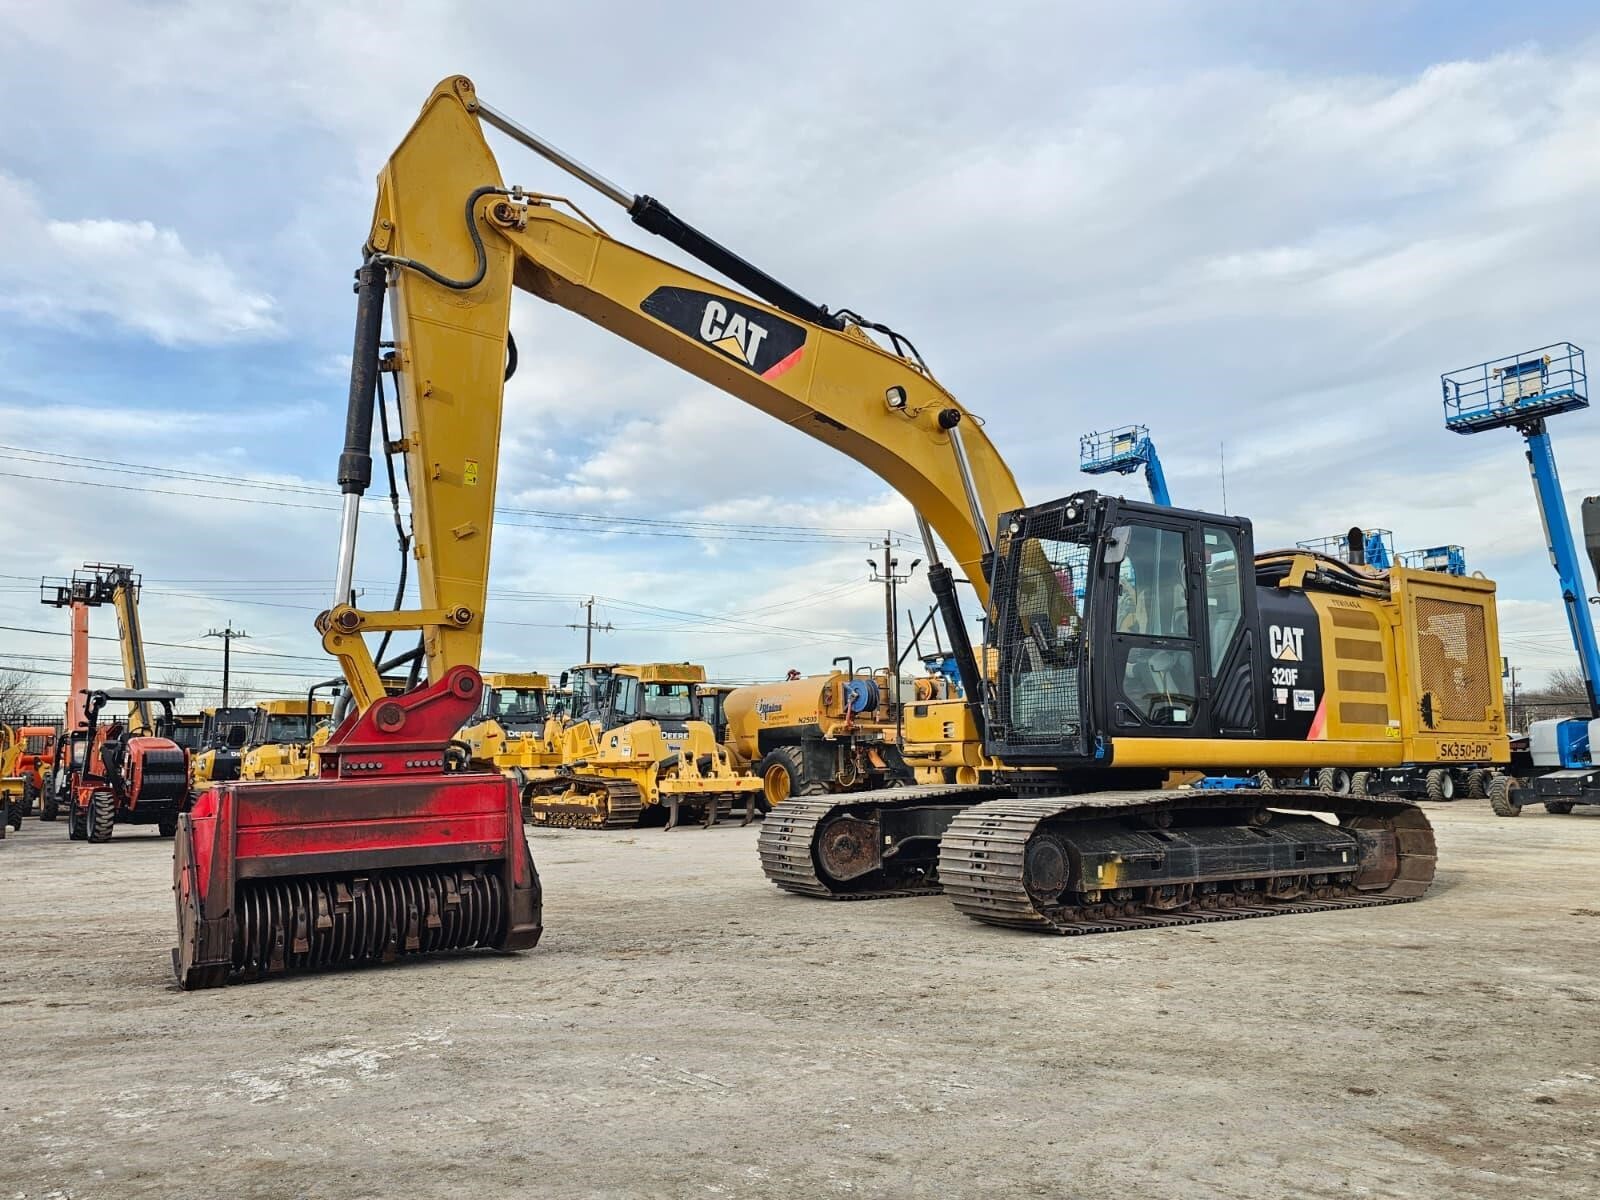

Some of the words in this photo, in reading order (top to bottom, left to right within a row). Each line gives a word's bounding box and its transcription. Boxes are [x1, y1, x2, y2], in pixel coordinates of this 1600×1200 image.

[700, 301, 768, 366] CAT
[1269, 624, 1304, 661] CAT
[1271, 667, 1298, 686] 320F
[661, 731, 689, 740] DEERE
[1440, 743, 1488, 758] SK350-PP
